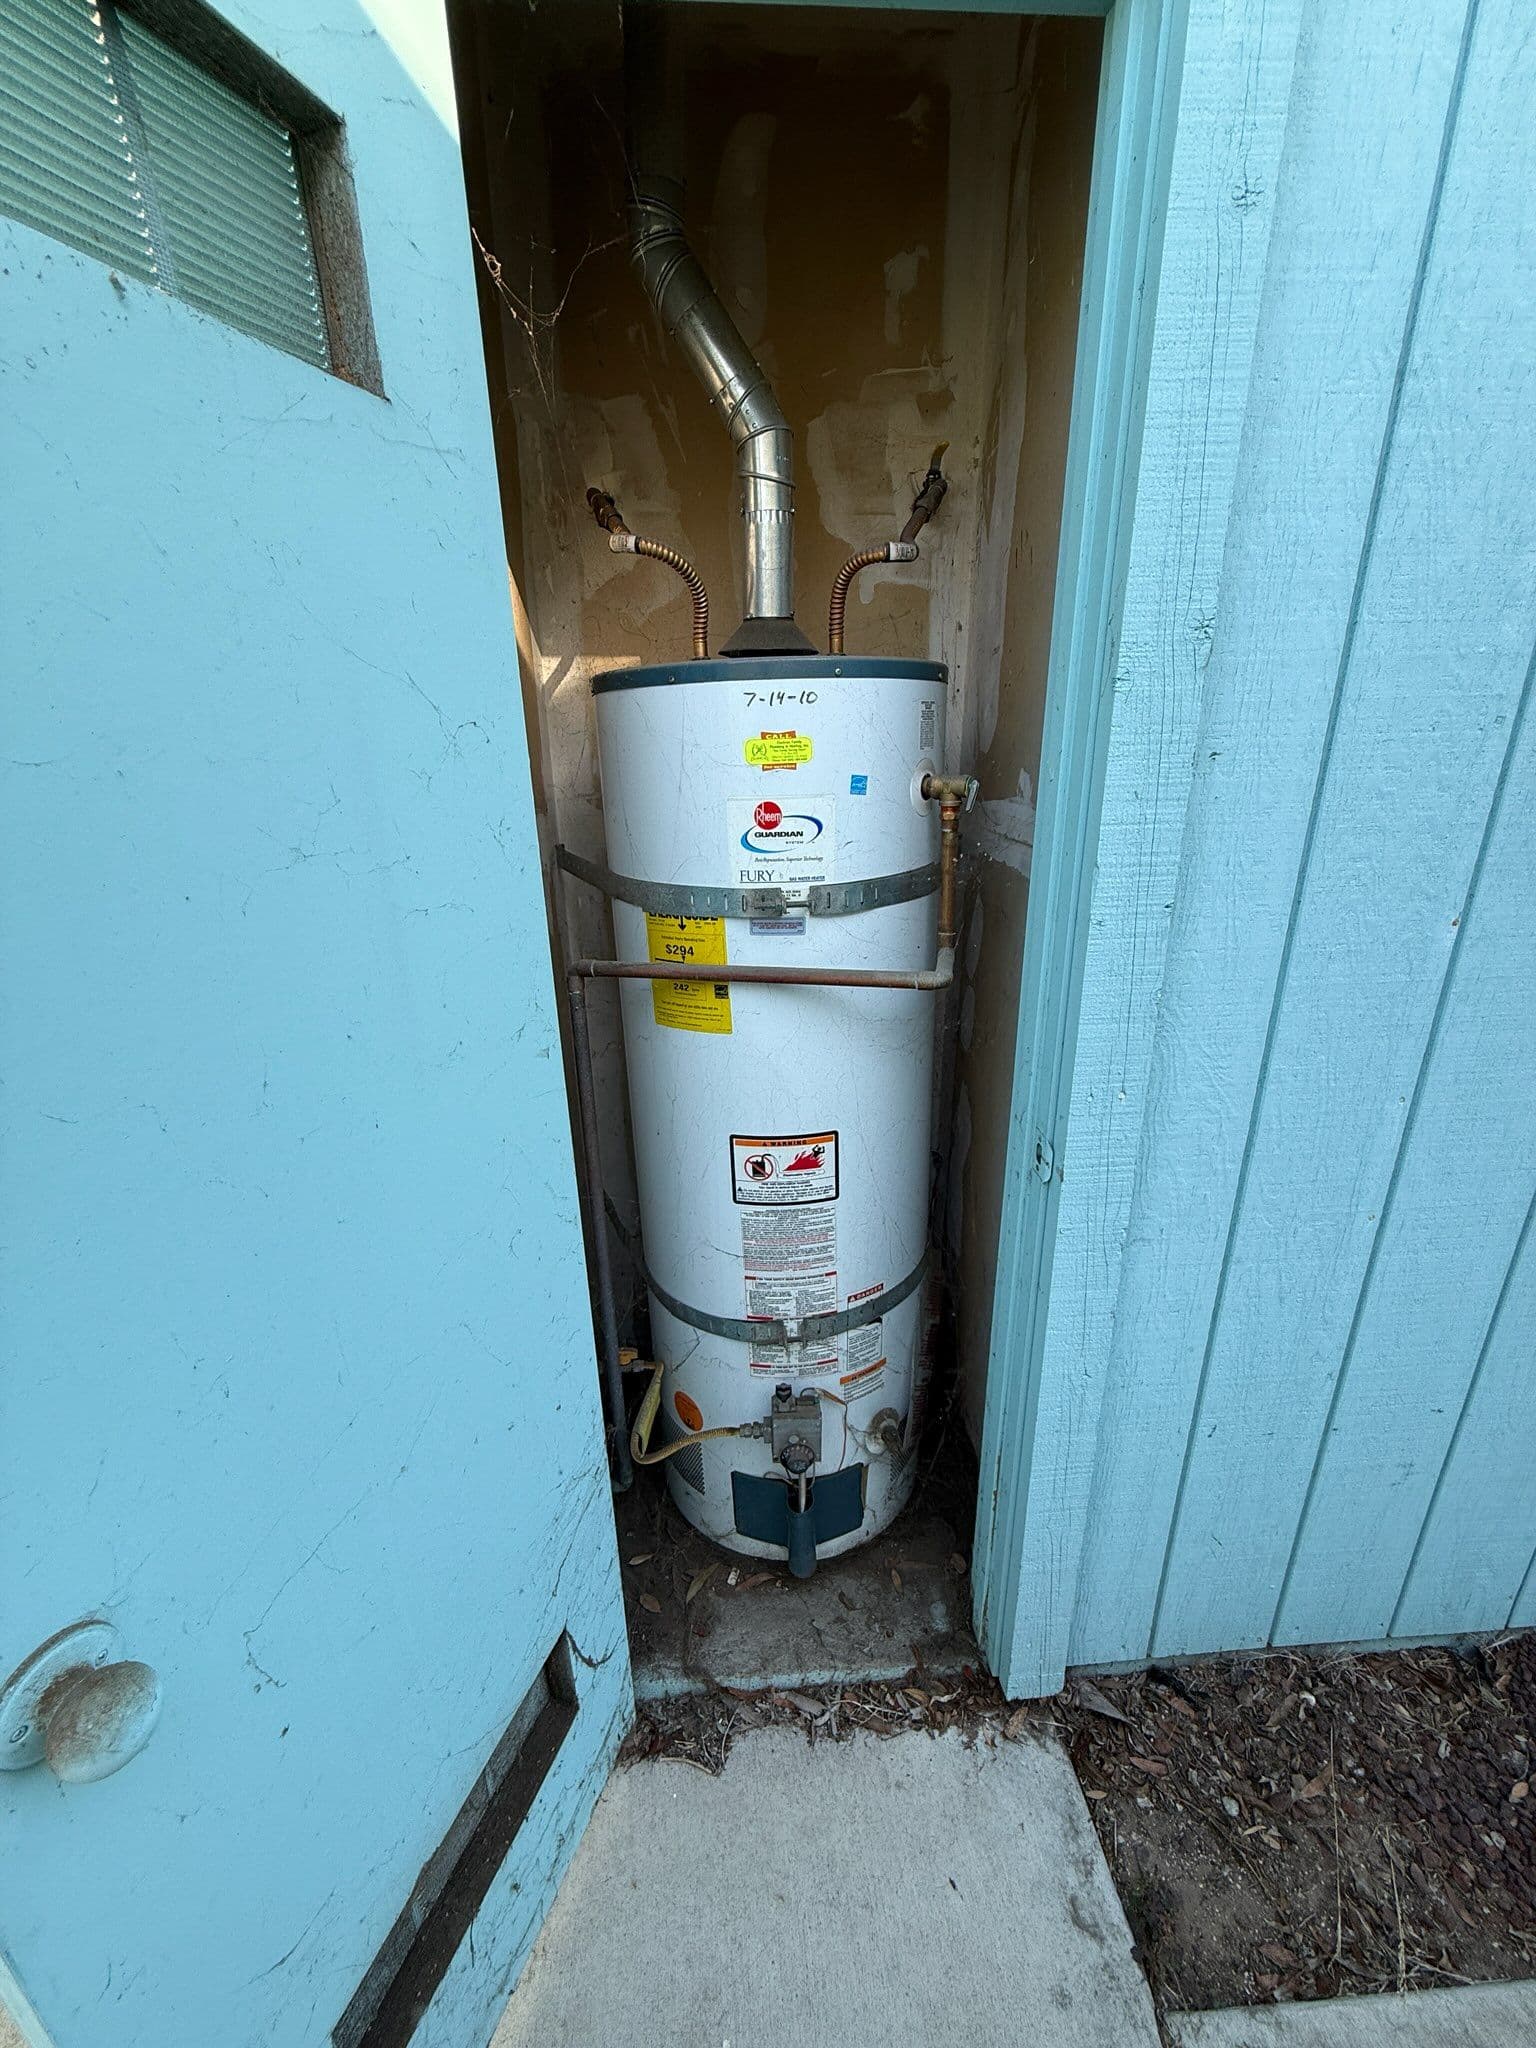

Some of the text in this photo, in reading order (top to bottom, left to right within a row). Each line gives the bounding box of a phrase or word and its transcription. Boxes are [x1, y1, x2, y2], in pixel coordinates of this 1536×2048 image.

[743, 690, 818, 707] 7-14-10
[756, 802, 781, 825] Rheem
[740, 869, 775, 881] FURY
[665, 943, 694, 956] $294
[673, 982, 689, 991] 242
